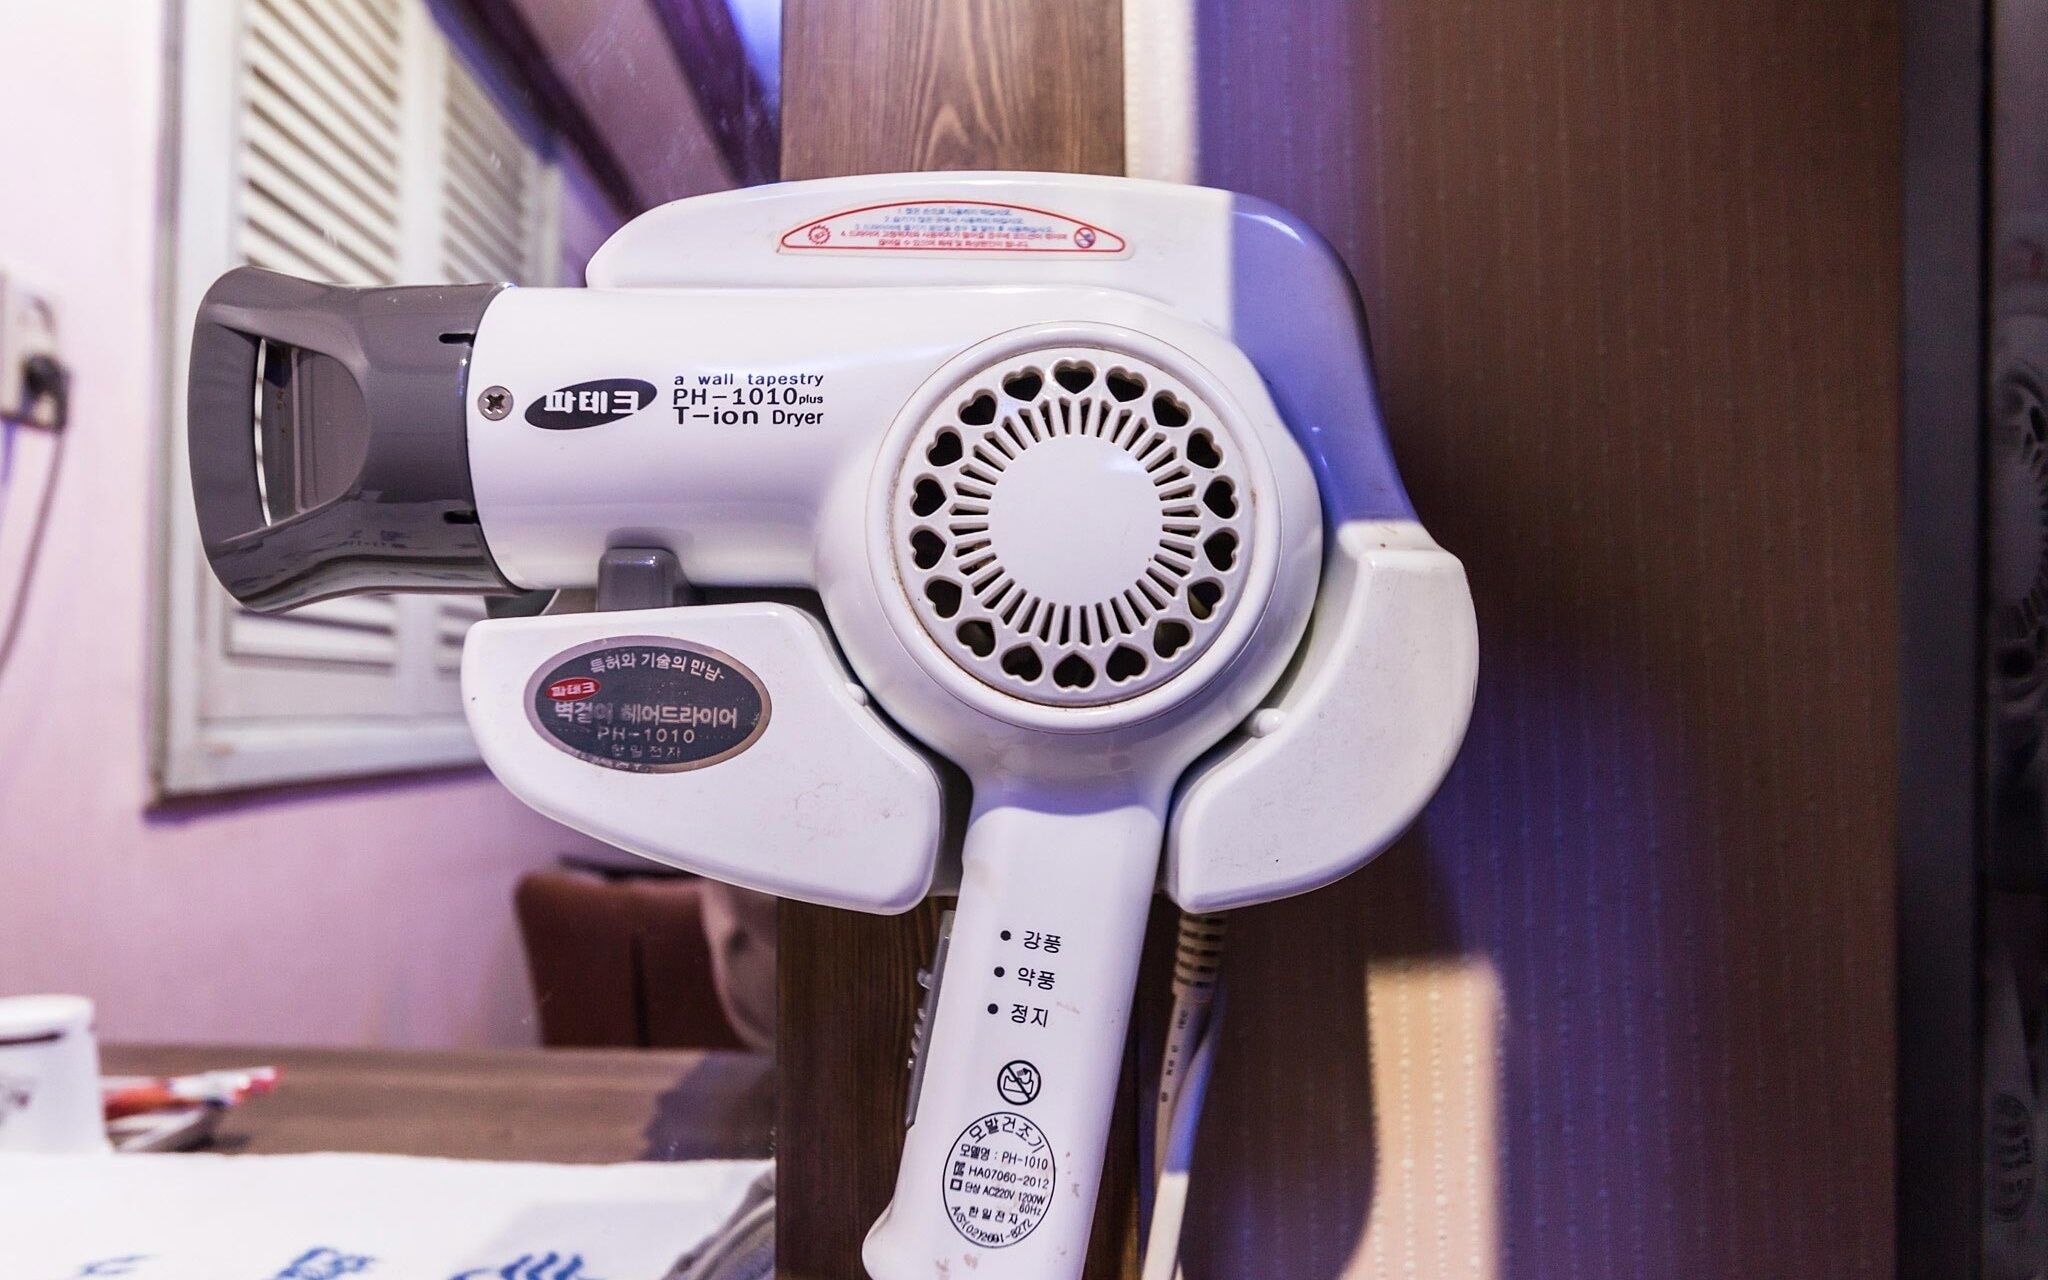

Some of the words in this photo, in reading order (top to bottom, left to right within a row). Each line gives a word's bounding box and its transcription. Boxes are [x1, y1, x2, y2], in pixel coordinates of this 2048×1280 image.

[674, 375, 684, 386] a
[698, 373, 734, 386] wall
[748, 373, 824, 387] tapestry
[543, 390, 640, 414] 파테크
[673, 406, 759, 425] T-ion
[772, 409, 824, 428] Dryer
[590, 652, 637, 674] 특허와
[641, 652, 687, 672] 기술의
[555, 701, 614, 724] 벽걸이
[621, 703, 738, 729] 헤어드라이어
[597, 726, 695, 744] PH-1010
[1023, 930, 1062, 954] 강풍
[1017, 967, 1056, 990] 약풍
[1010, 1003, 1049, 1028] 정지
[968, 1116, 1045, 1154] 모발건조기
[960, 1143, 991, 1161] 모델명
[1001, 1151, 1048, 1170] PH-1010
[982, 1185, 1016, 1200] AC220V
[1018, 1191, 1046, 1205] 1200W
